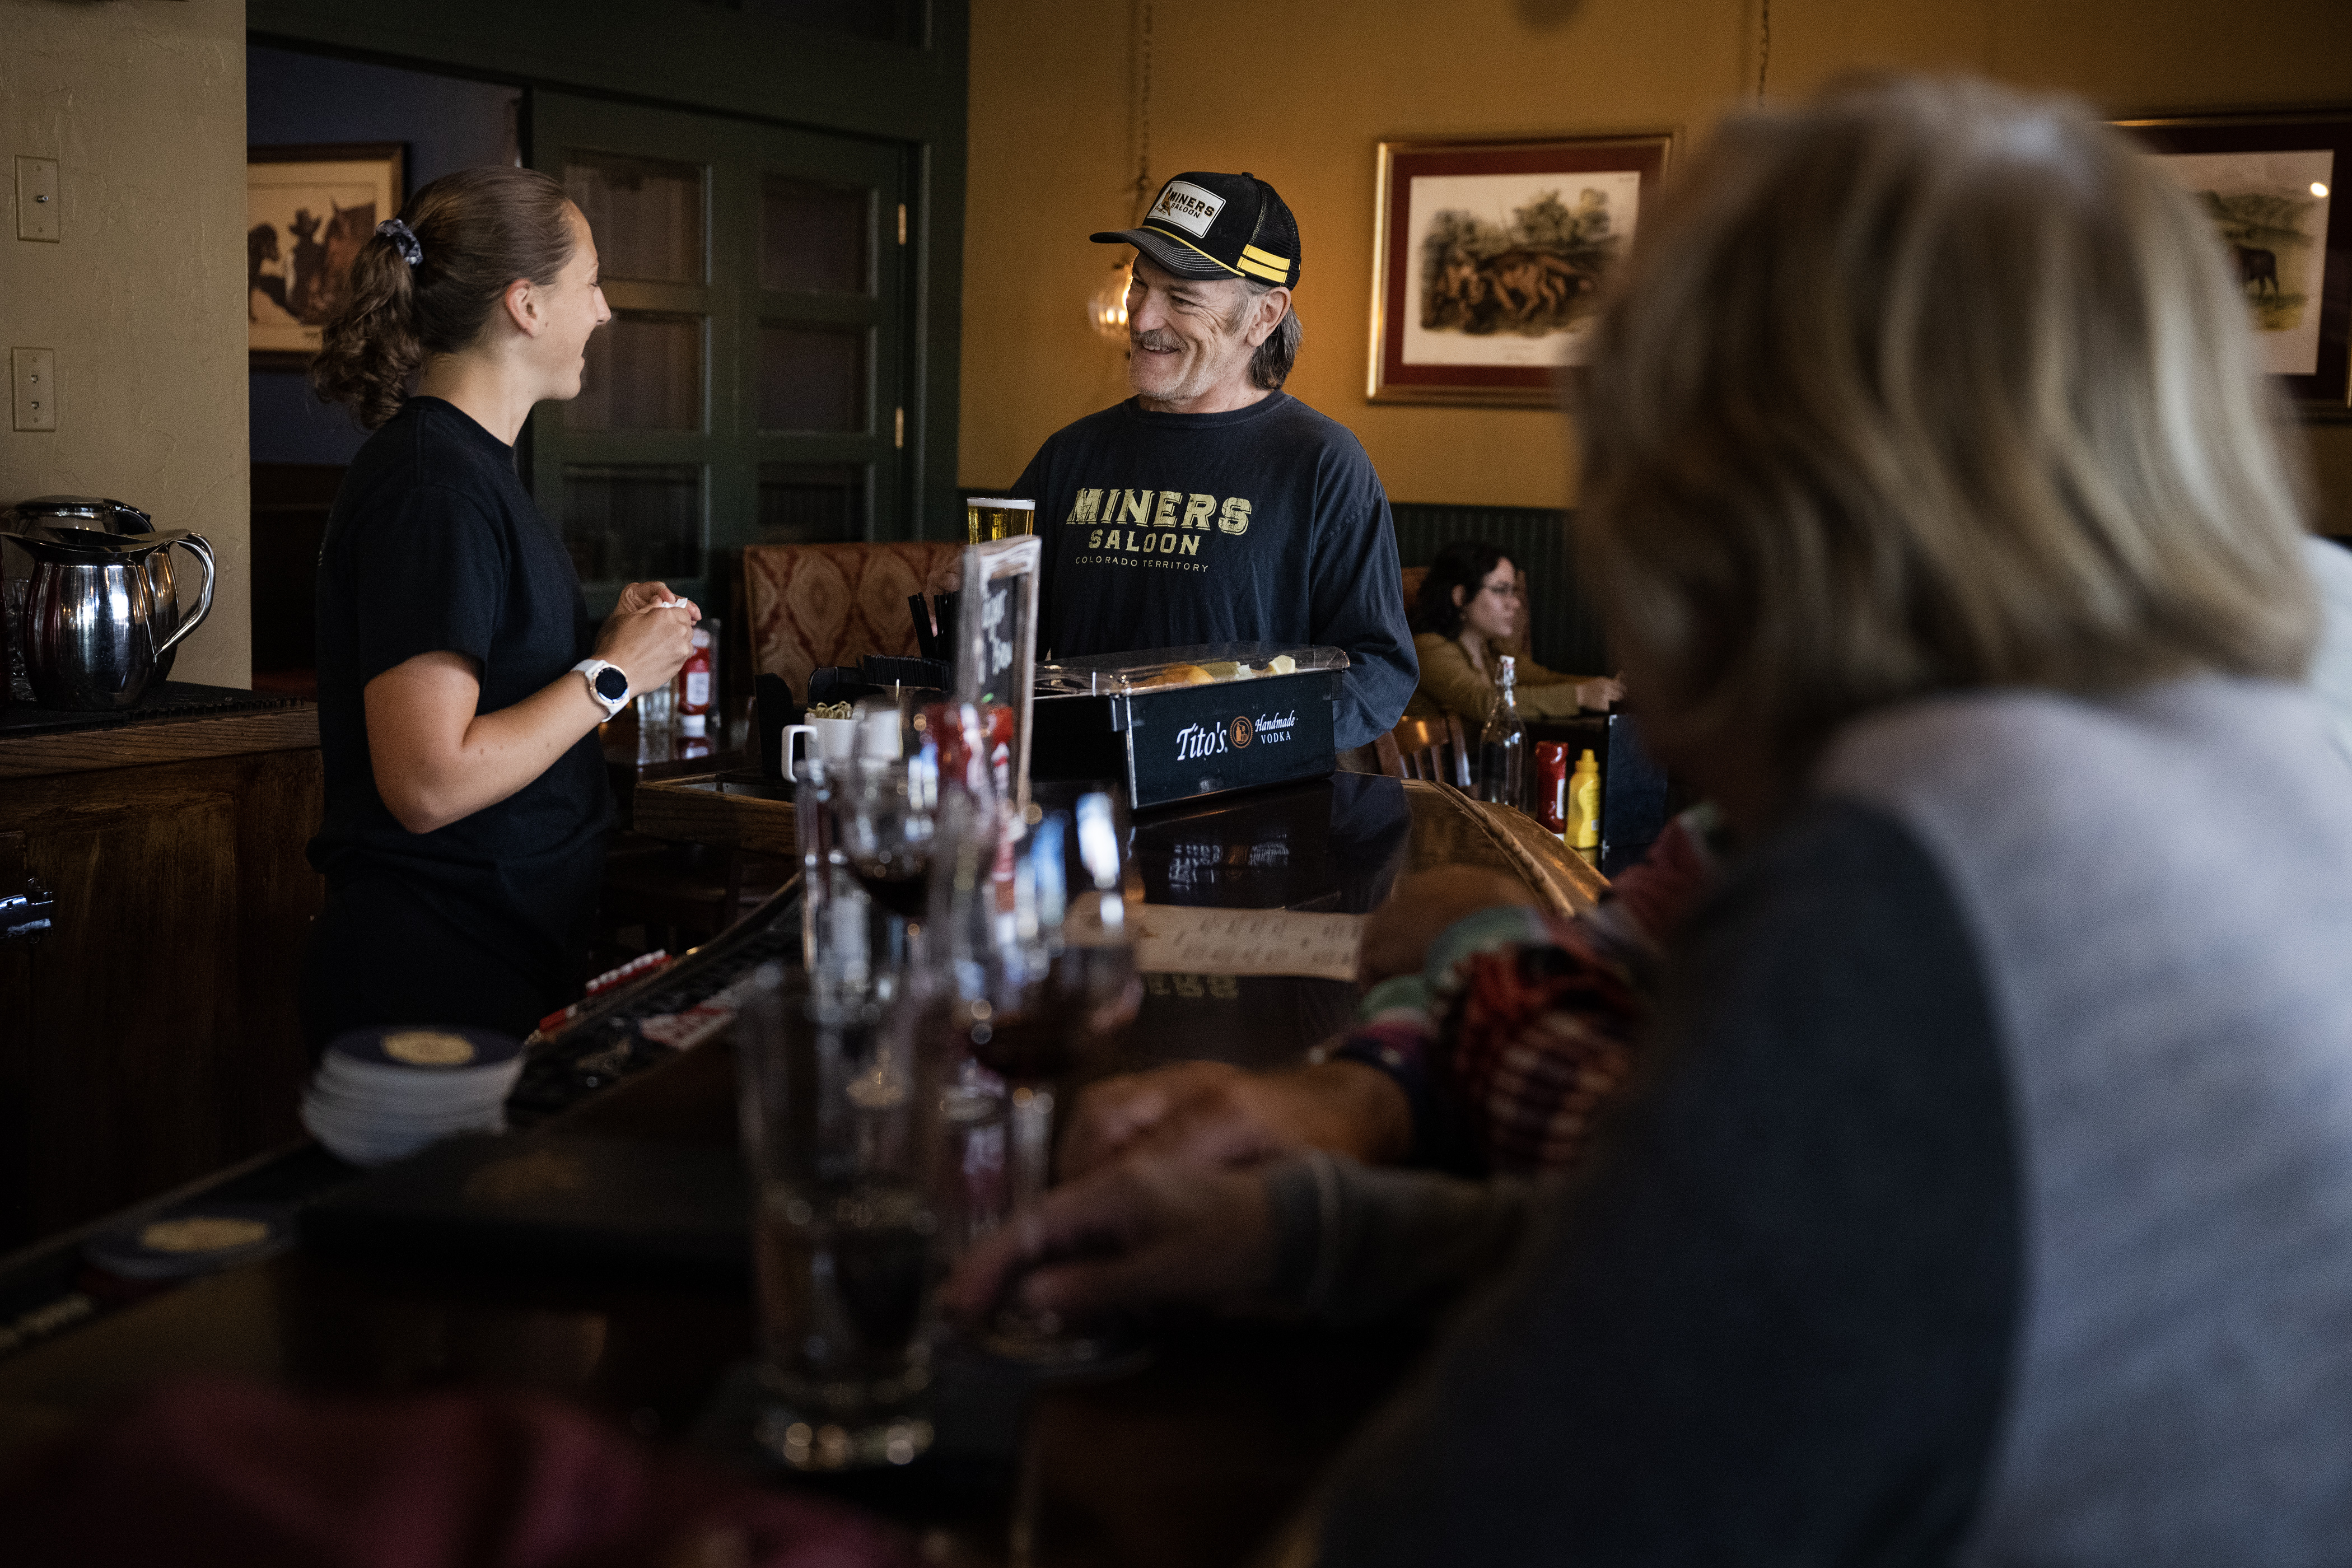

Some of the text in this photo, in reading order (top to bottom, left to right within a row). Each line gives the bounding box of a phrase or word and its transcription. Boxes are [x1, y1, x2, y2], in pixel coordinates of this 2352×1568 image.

[1169, 191, 1215, 217] MINERS
[1170, 202, 1201, 218] SALOON
[1066, 487, 1252, 535] MINERS
[1088, 529, 1201, 556] SALOON
[1075, 556, 1208, 572] COLORADO TERRITORY
[1254, 710, 1296, 732] Handmade
[1176, 721, 1227, 761] Tito's
[1261, 731, 1291, 744] VODKA
